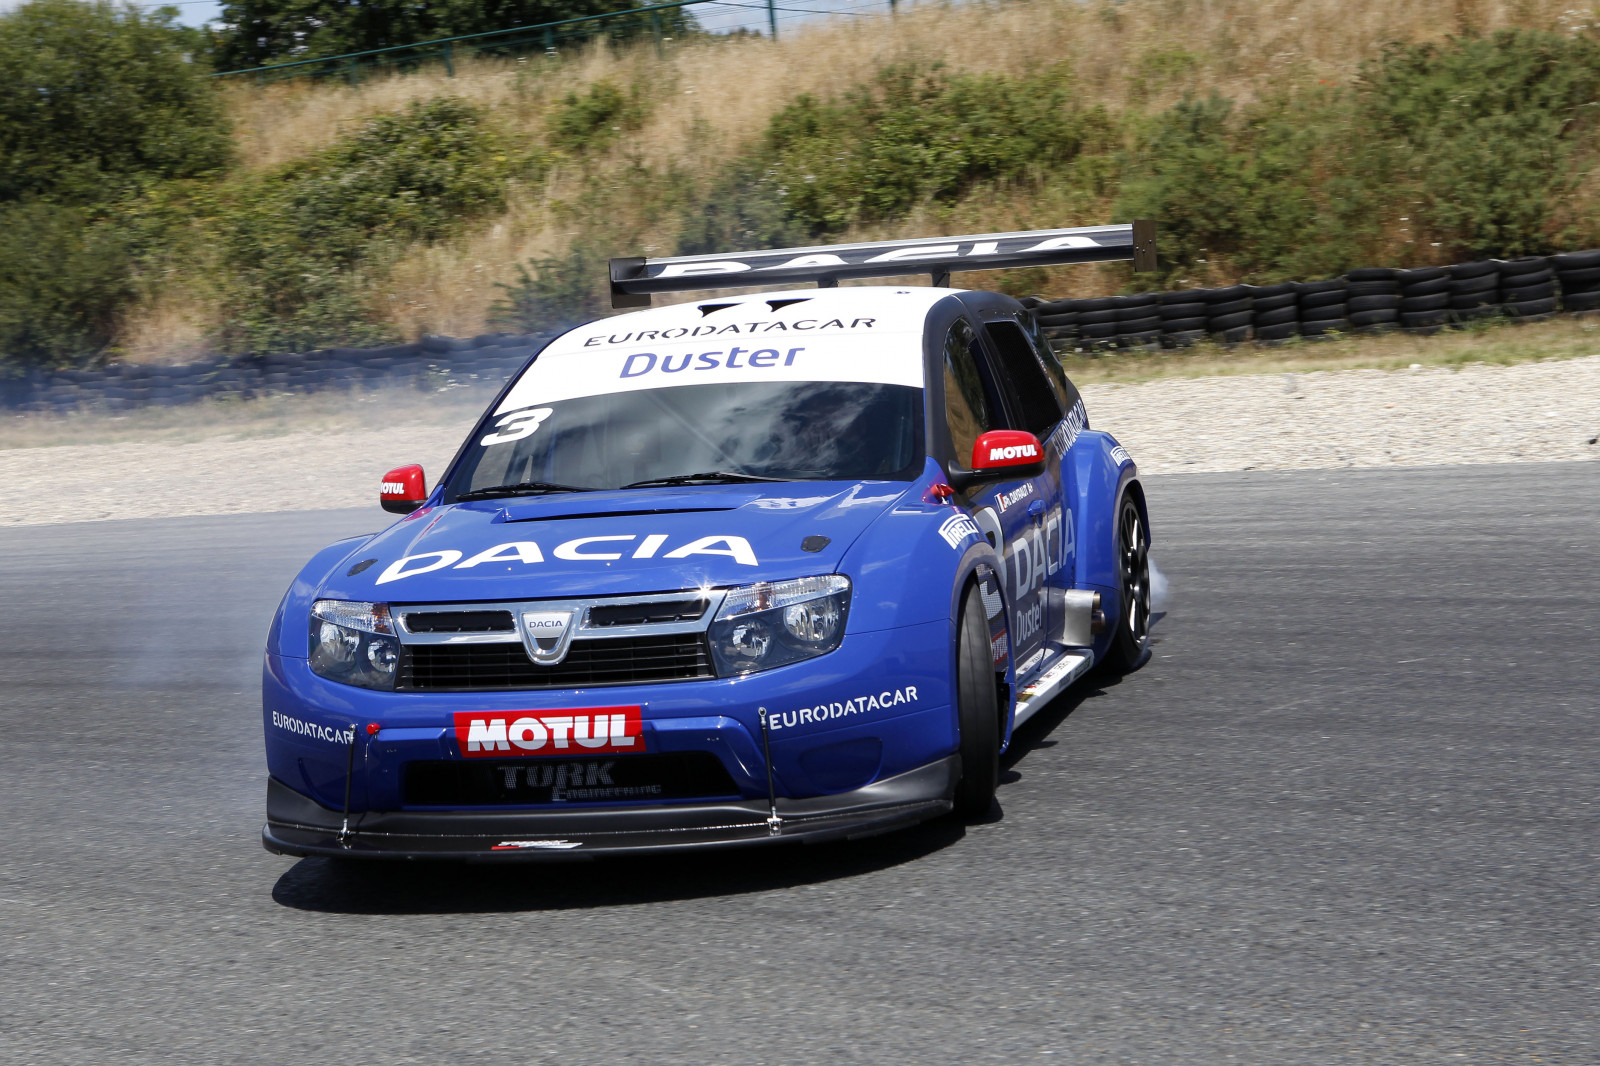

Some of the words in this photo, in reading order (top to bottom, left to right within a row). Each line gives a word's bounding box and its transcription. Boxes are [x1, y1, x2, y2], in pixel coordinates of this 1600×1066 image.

[584, 317, 877, 348] EURODATACAR
[619, 346, 806, 379] Duster
[480, 407, 554, 447] 3
[990, 444, 1037, 461] MOTUL
[380, 482, 405, 494] OTUL
[937, 513, 980, 550] PIRELLI
[375, 534, 759, 586] DACIA
[1012, 507, 1076, 601] DACIA
[529, 620, 563, 629] DACIA
[1016, 601, 1043, 647] Duster
[769, 685, 918, 730] EURODATACAR
[272, 710, 353, 745] EURODATACAR
[467, 714, 635, 752] MOTUL
